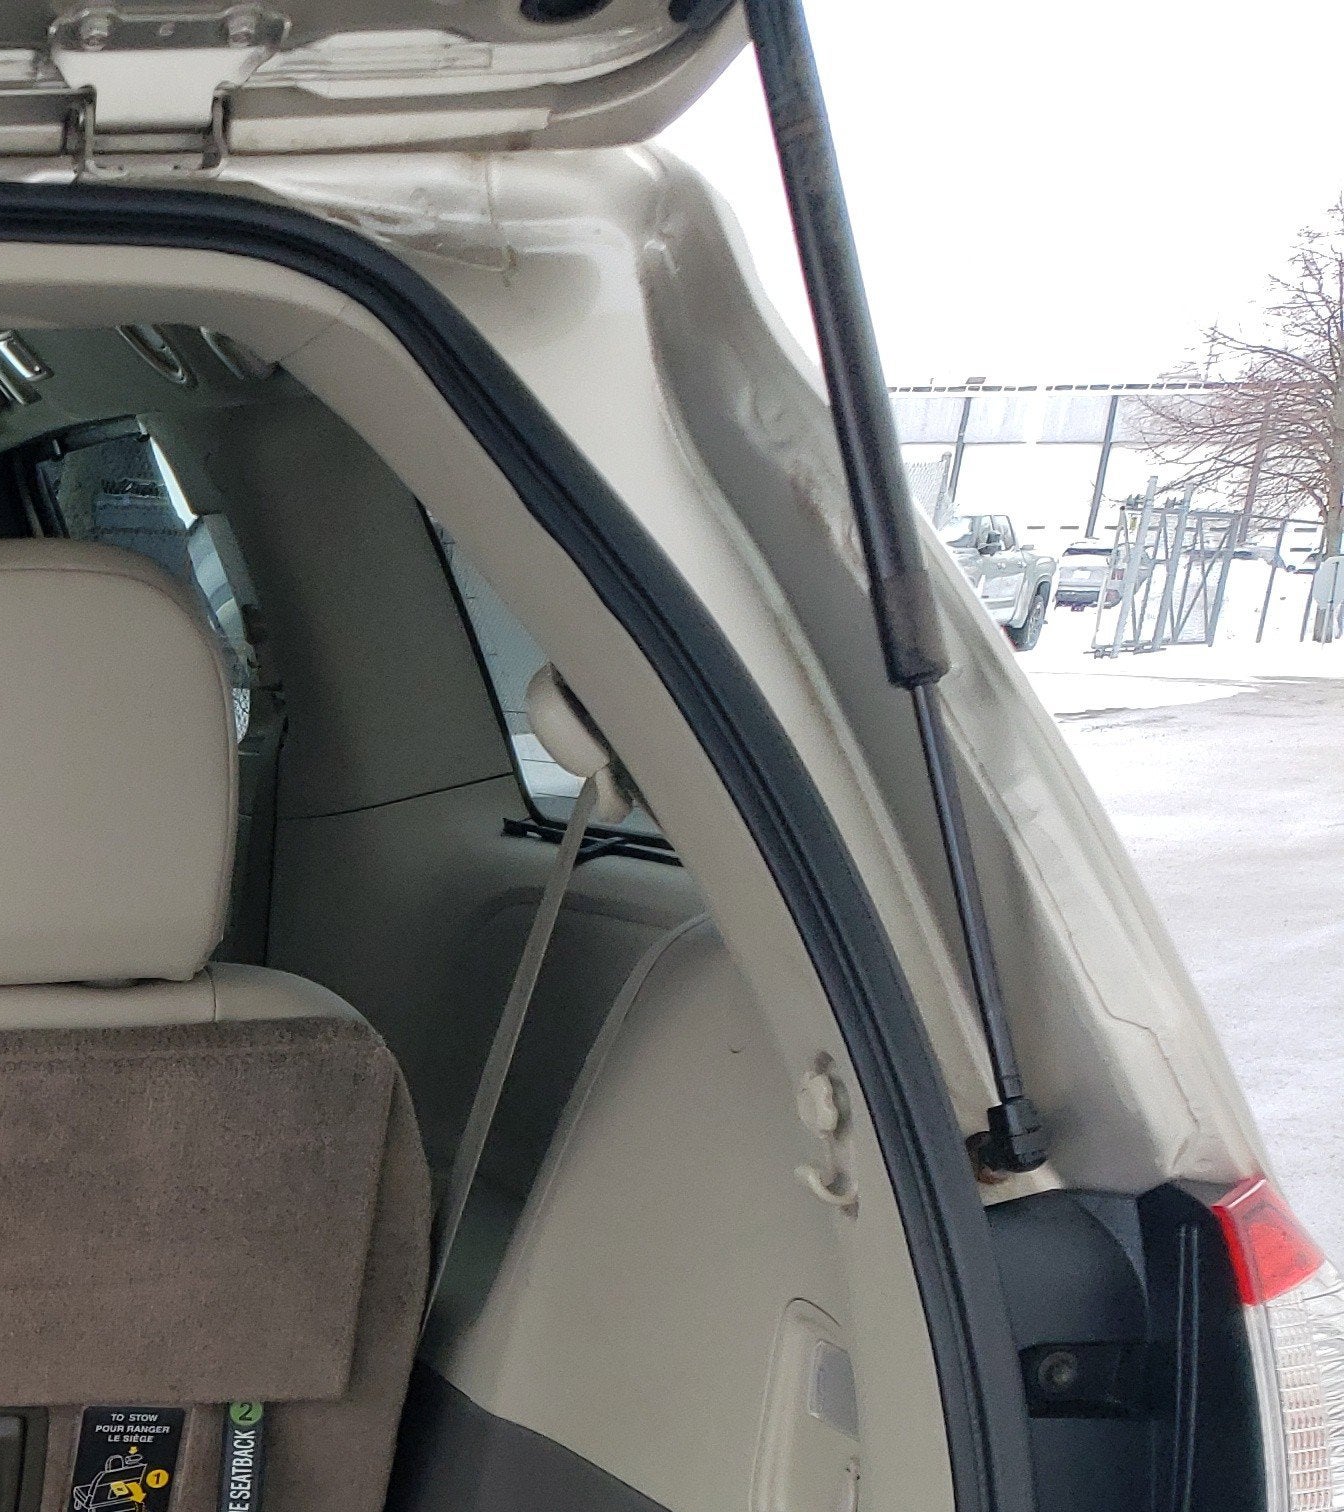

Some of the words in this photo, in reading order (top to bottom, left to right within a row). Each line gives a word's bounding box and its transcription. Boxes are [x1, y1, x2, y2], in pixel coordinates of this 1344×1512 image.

[239, 1402, 253, 1421] 2
[111, 1413, 125, 1422] TO
[128, 1413, 158, 1422] STOW
[95, 1425, 124, 1433] POUR
[126, 1425, 170, 1434] RANGER
[107, 1434, 121, 1442] LE
[230, 1430, 256, 1500] SEATBACK
